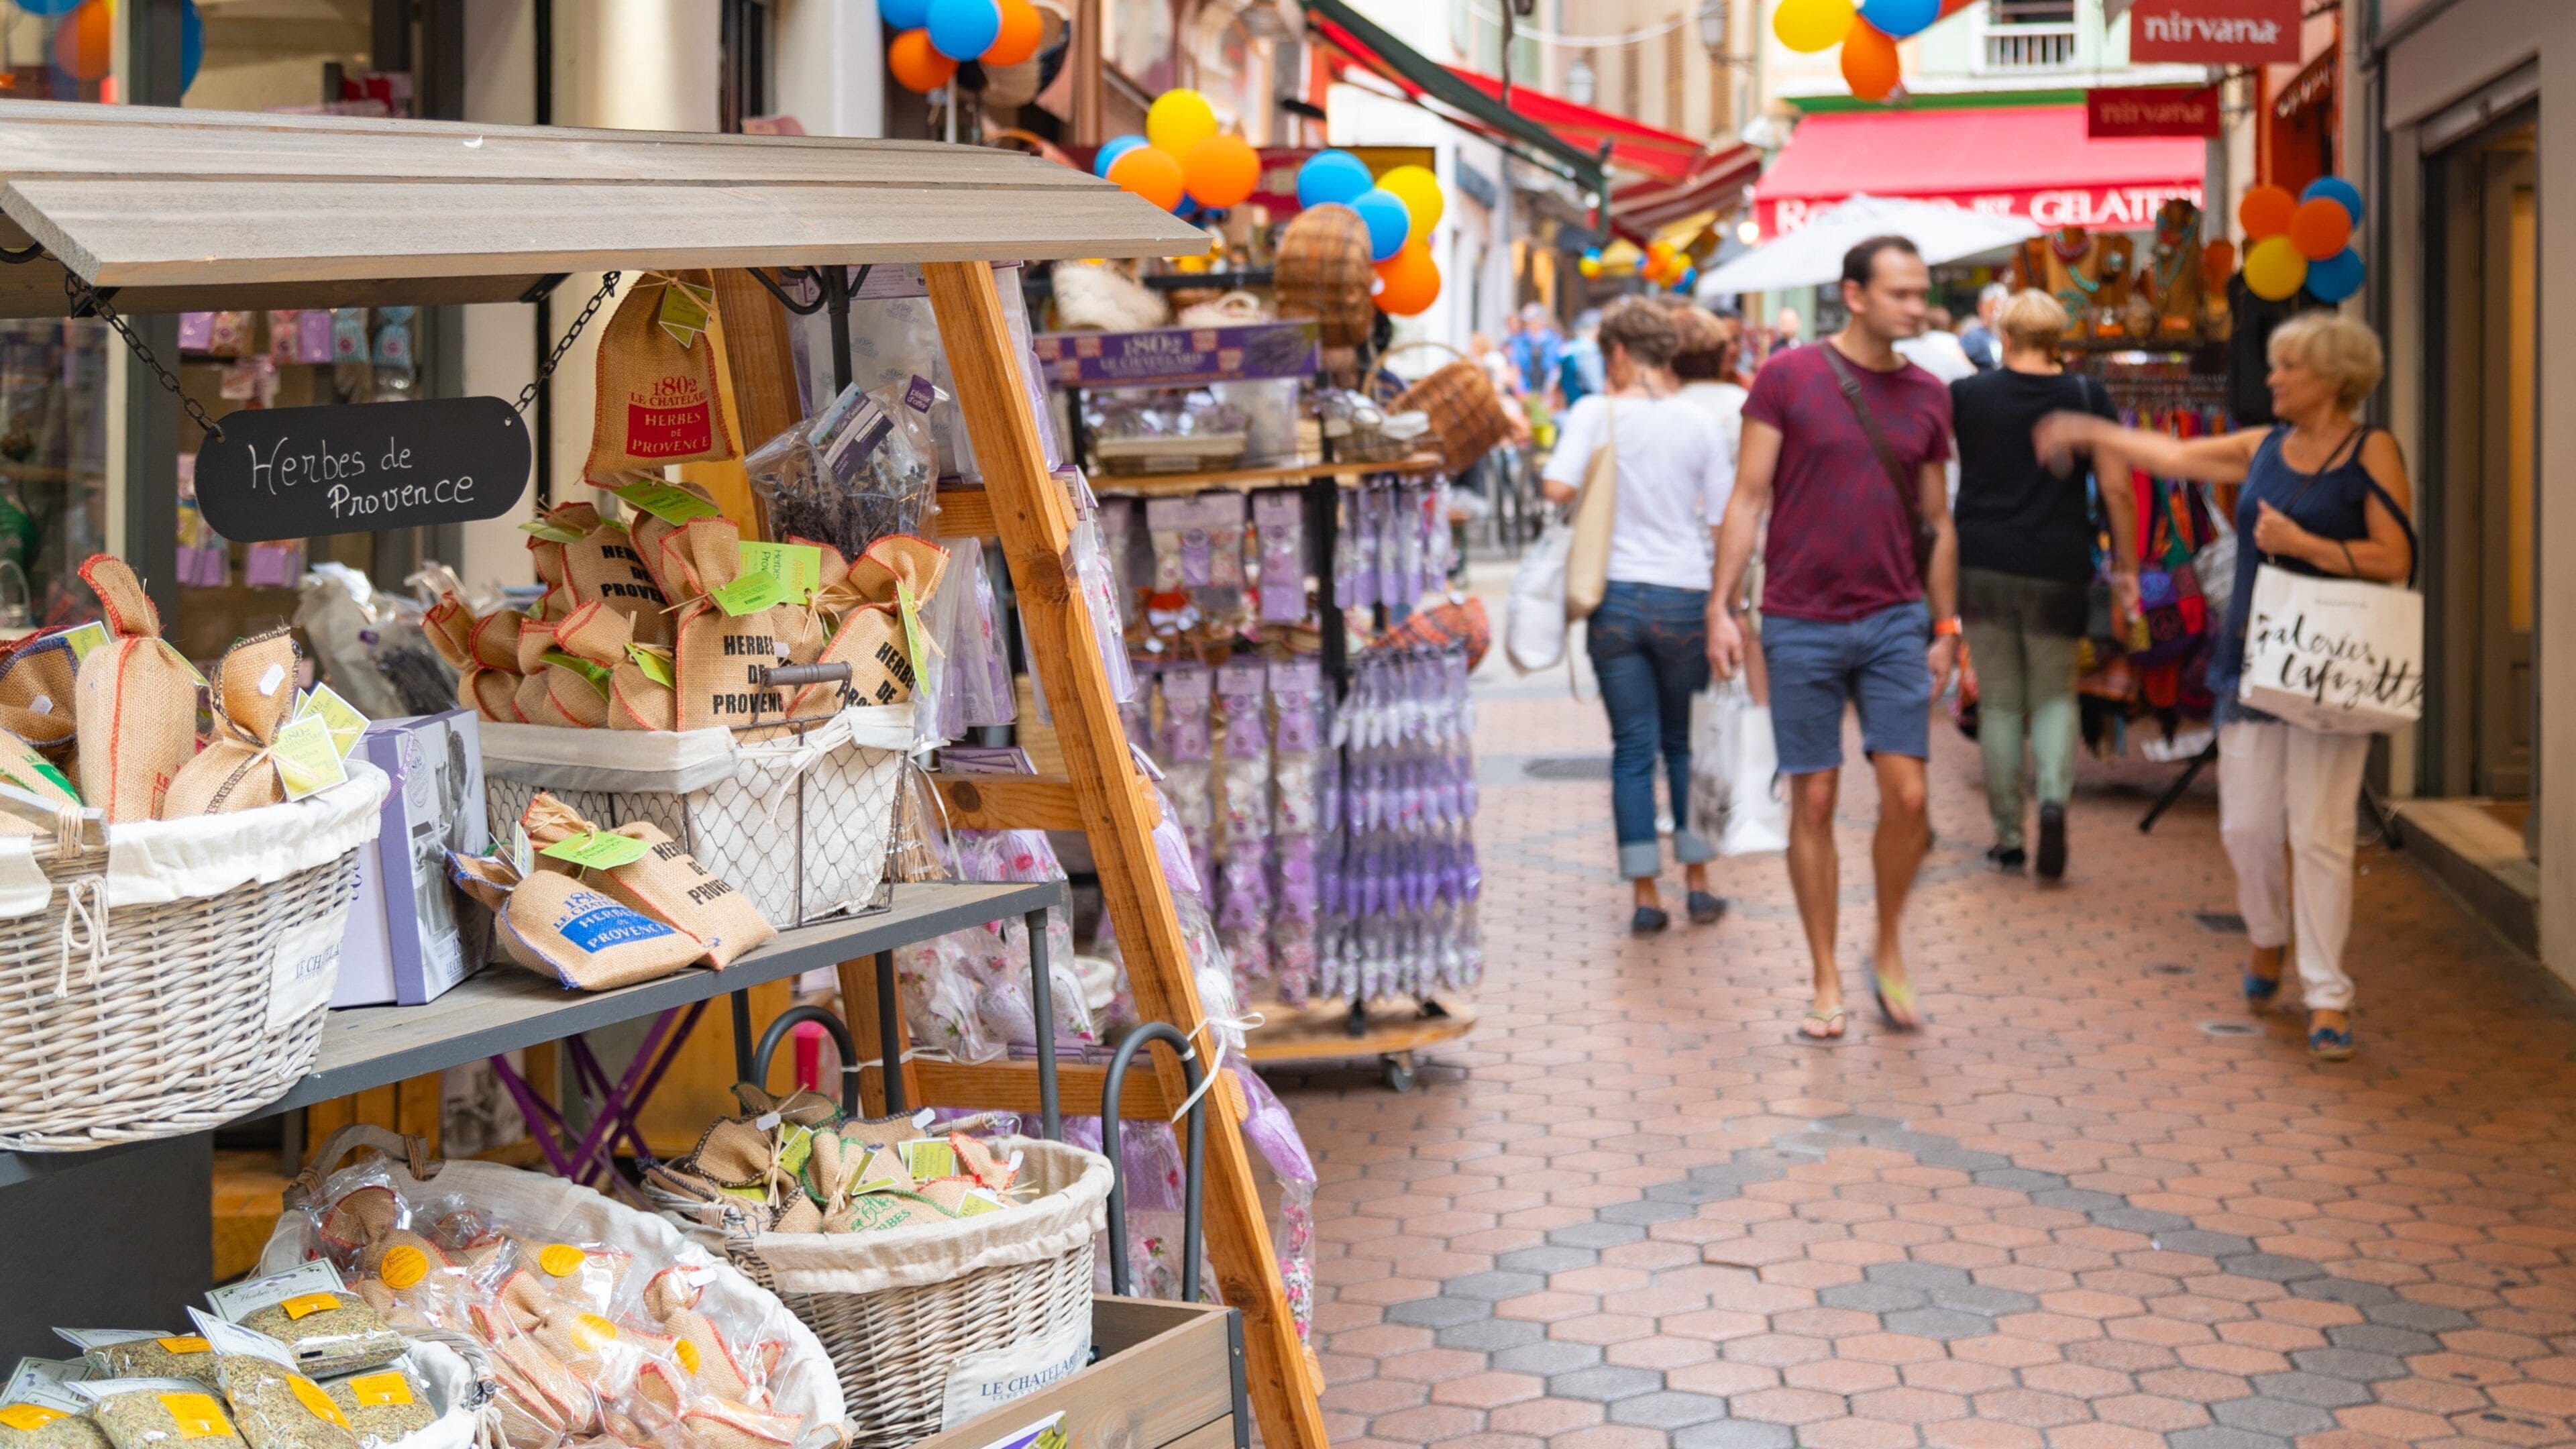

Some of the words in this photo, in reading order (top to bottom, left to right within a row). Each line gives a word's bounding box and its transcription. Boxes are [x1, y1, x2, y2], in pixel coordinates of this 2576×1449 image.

[2144, 11, 2280, 44] nirvana
[2100, 99, 2204, 124] nirvana
[653, 376, 697, 396] 1802
[631, 392, 646, 405] LE
[910, 389, 931, 404] plaisir
[645, 412, 701, 427] HERBES
[671, 429, 682, 437] DE
[632, 436, 709, 453] PROVENCE
[248, 437, 365, 495] Herbes
[380, 436, 413, 470] de
[327, 476, 474, 519] Provence
[724, 635, 775, 655] HERBES
[875, 679, 898, 705] DE
[981, 1381, 1004, 1397] LE
